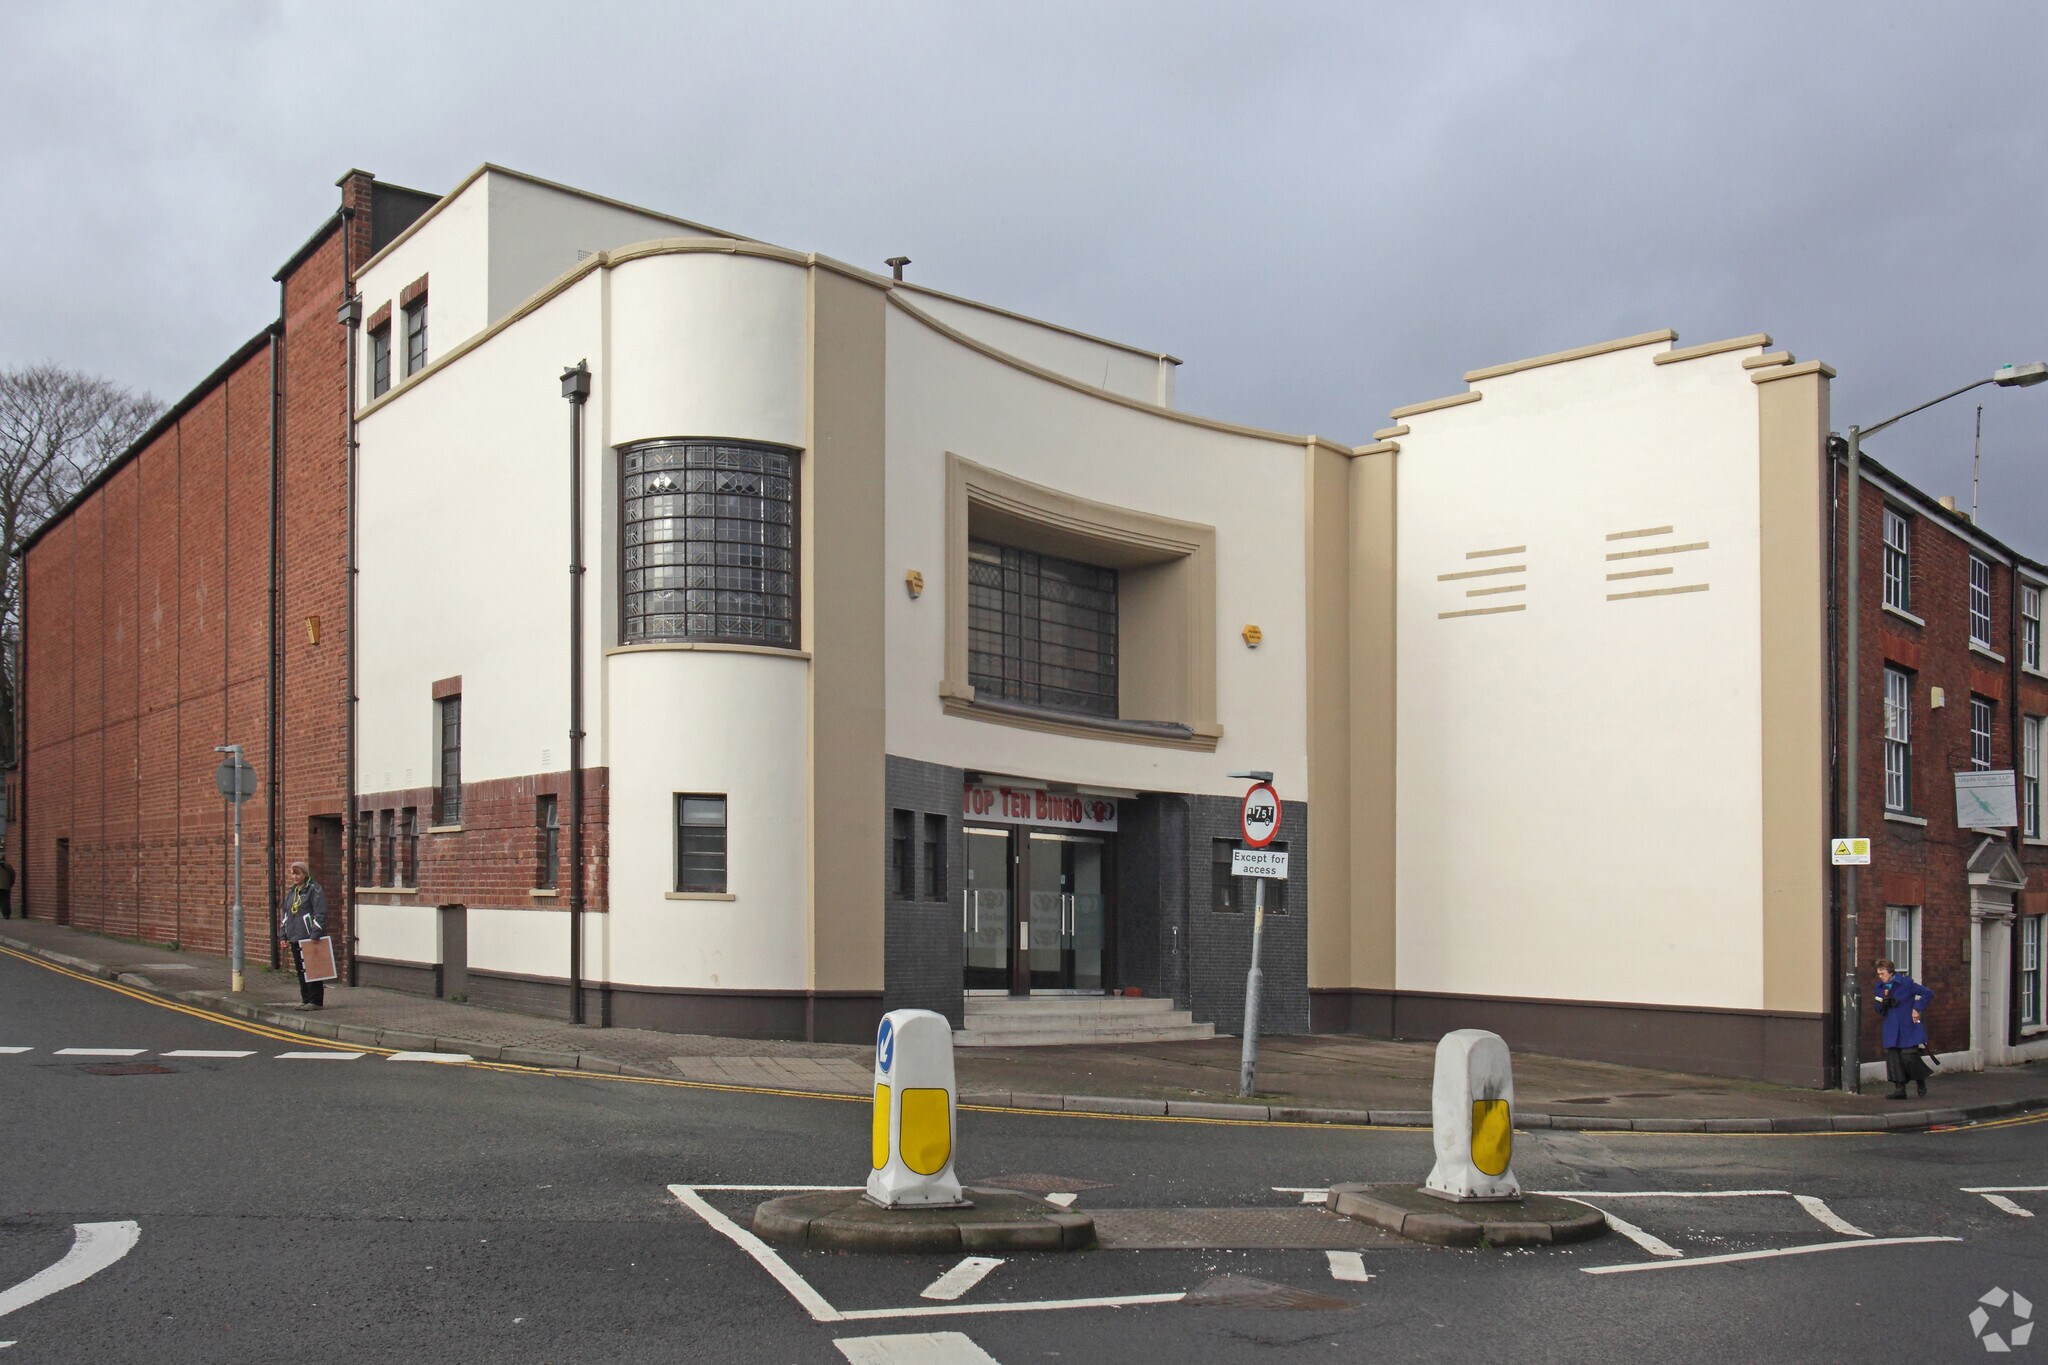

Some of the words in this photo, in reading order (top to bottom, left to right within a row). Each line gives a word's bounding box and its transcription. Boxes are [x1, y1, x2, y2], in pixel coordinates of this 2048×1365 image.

[1035, 789, 1083, 824] BINGO
[1234, 851, 1267, 863] Except
[1271, 854, 1286, 864] for
[1243, 865, 1277, 875] access
